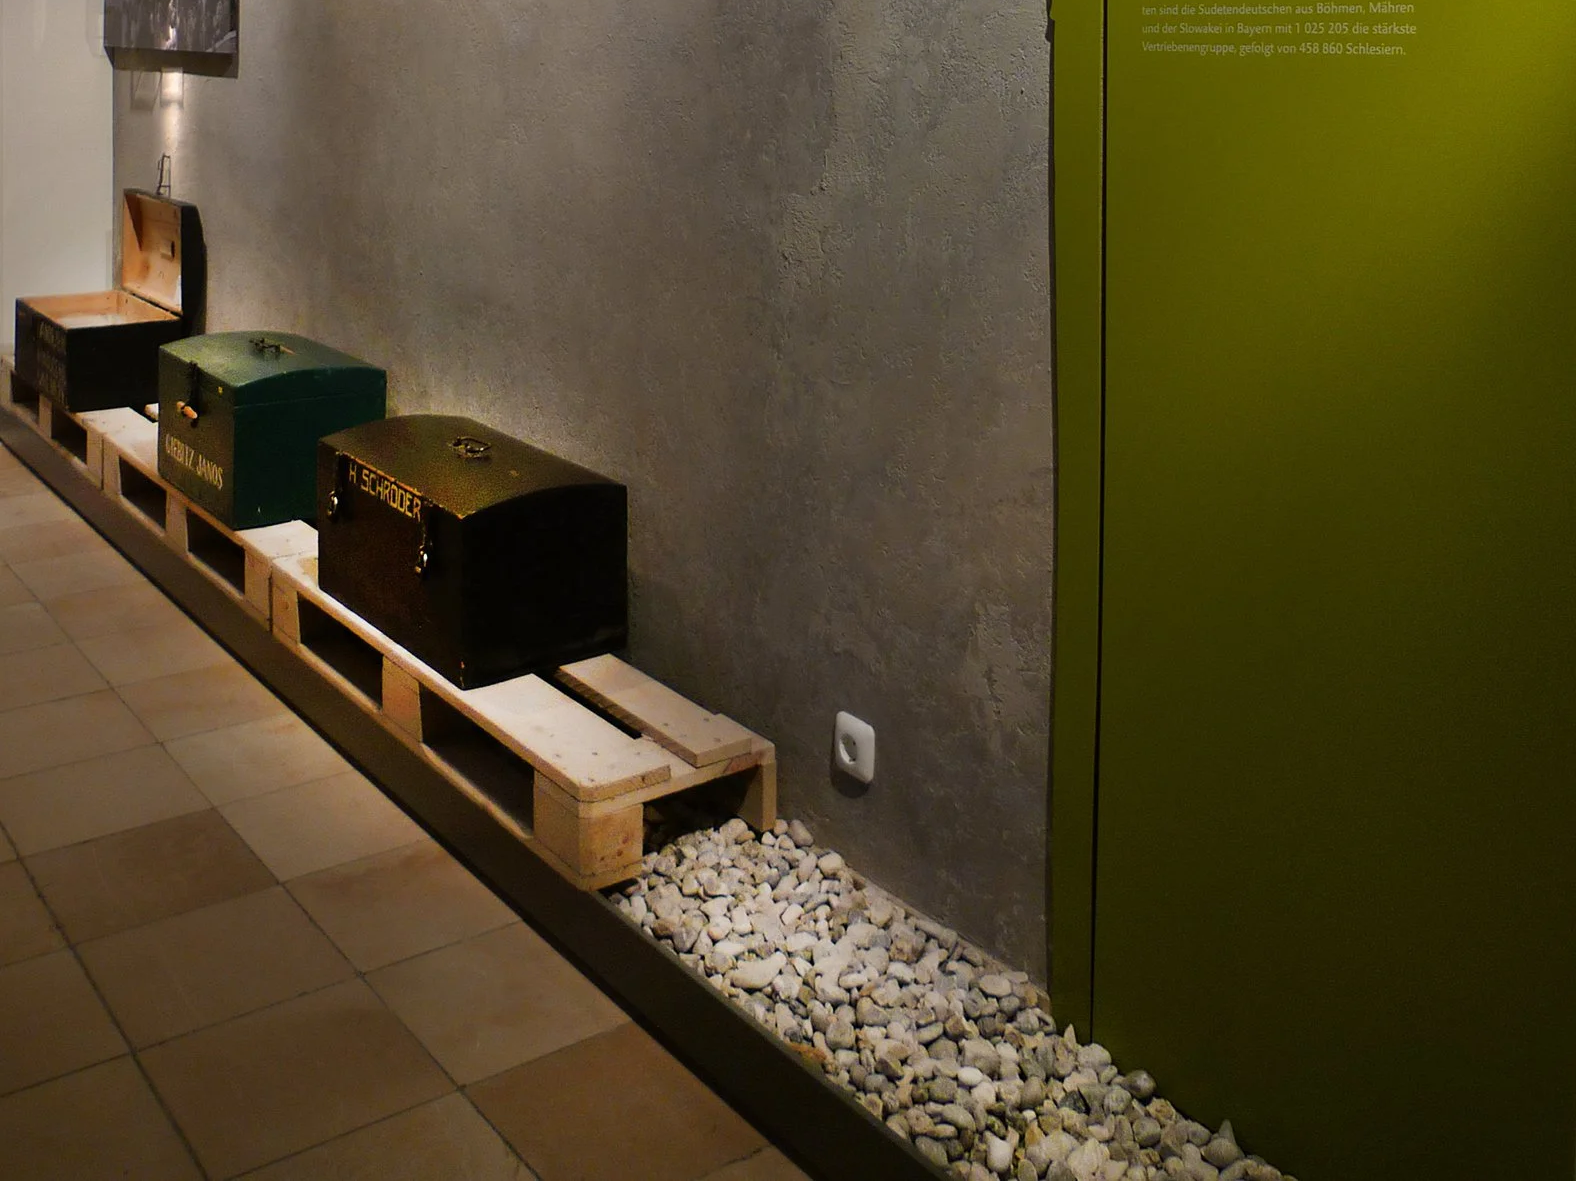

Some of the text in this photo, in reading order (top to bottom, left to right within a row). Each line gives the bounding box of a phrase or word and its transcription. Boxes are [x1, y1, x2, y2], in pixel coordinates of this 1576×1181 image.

[1142, 6, 1156, 15] ten
[1159, 4, 1178, 15] sind
[1180, 4, 1196, 15] die
[1198, 3, 1292, 15] Sudetendeutschen
[1294, 5, 1313, 14] aus
[1368, 1, 1414, 13] Mähren
[1142, 23, 1159, 33] und
[1161, 22, 1177, 34] der
[1224, 25, 1234, 33] in
[1236, 22, 1272, 37] Bayern
[1274, 24, 1292, 34] mit
[1304, 22, 1324, 34] 025
[1327, 22, 1348, 34] 205
[1351, 22, 1369, 34] die
[1372, 22, 1416, 35] stärkste
[1239, 42, 1274, 57] gefolgt
[1276, 45, 1296, 54] von
[1298, 42, 1319, 54] 458
[1322, 42, 1343, 54] 860
